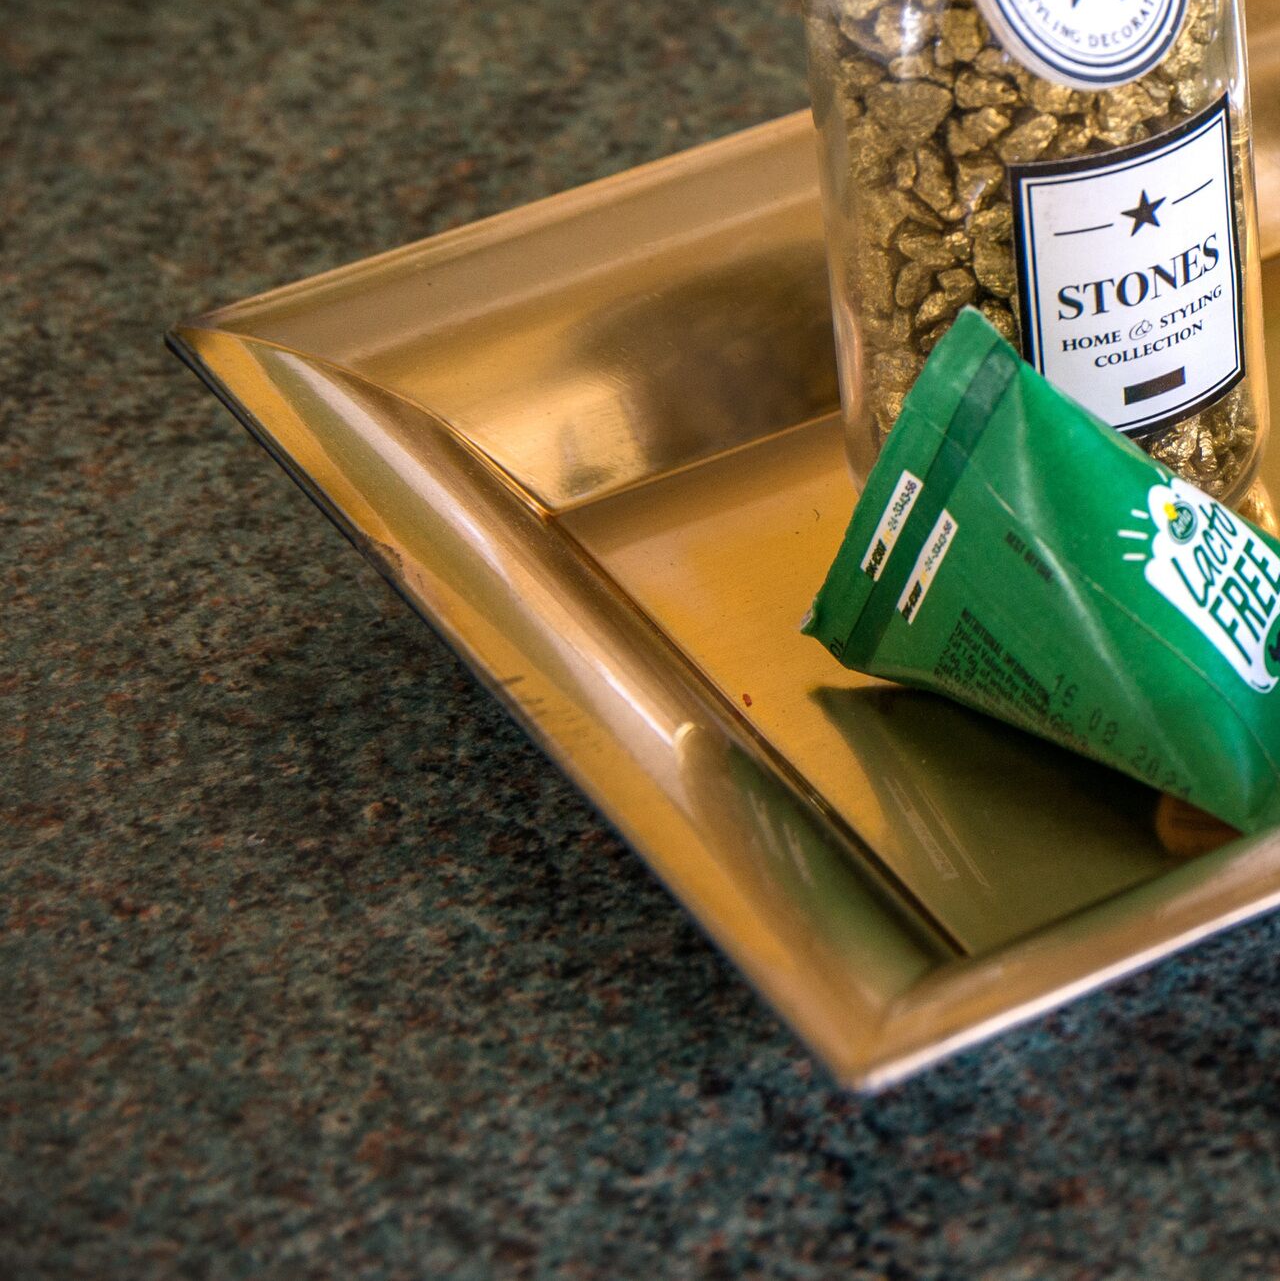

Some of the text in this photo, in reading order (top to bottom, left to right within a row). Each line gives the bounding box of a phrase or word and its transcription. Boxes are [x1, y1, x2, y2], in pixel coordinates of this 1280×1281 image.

[1057, 232, 1220, 322] STONES
[1061, 329, 1122, 352] HOME
[1159, 284, 1223, 329] STYLING
[1093, 319, 1204, 368] COLLECTION
[1170, 501, 1238, 608] Lacto
